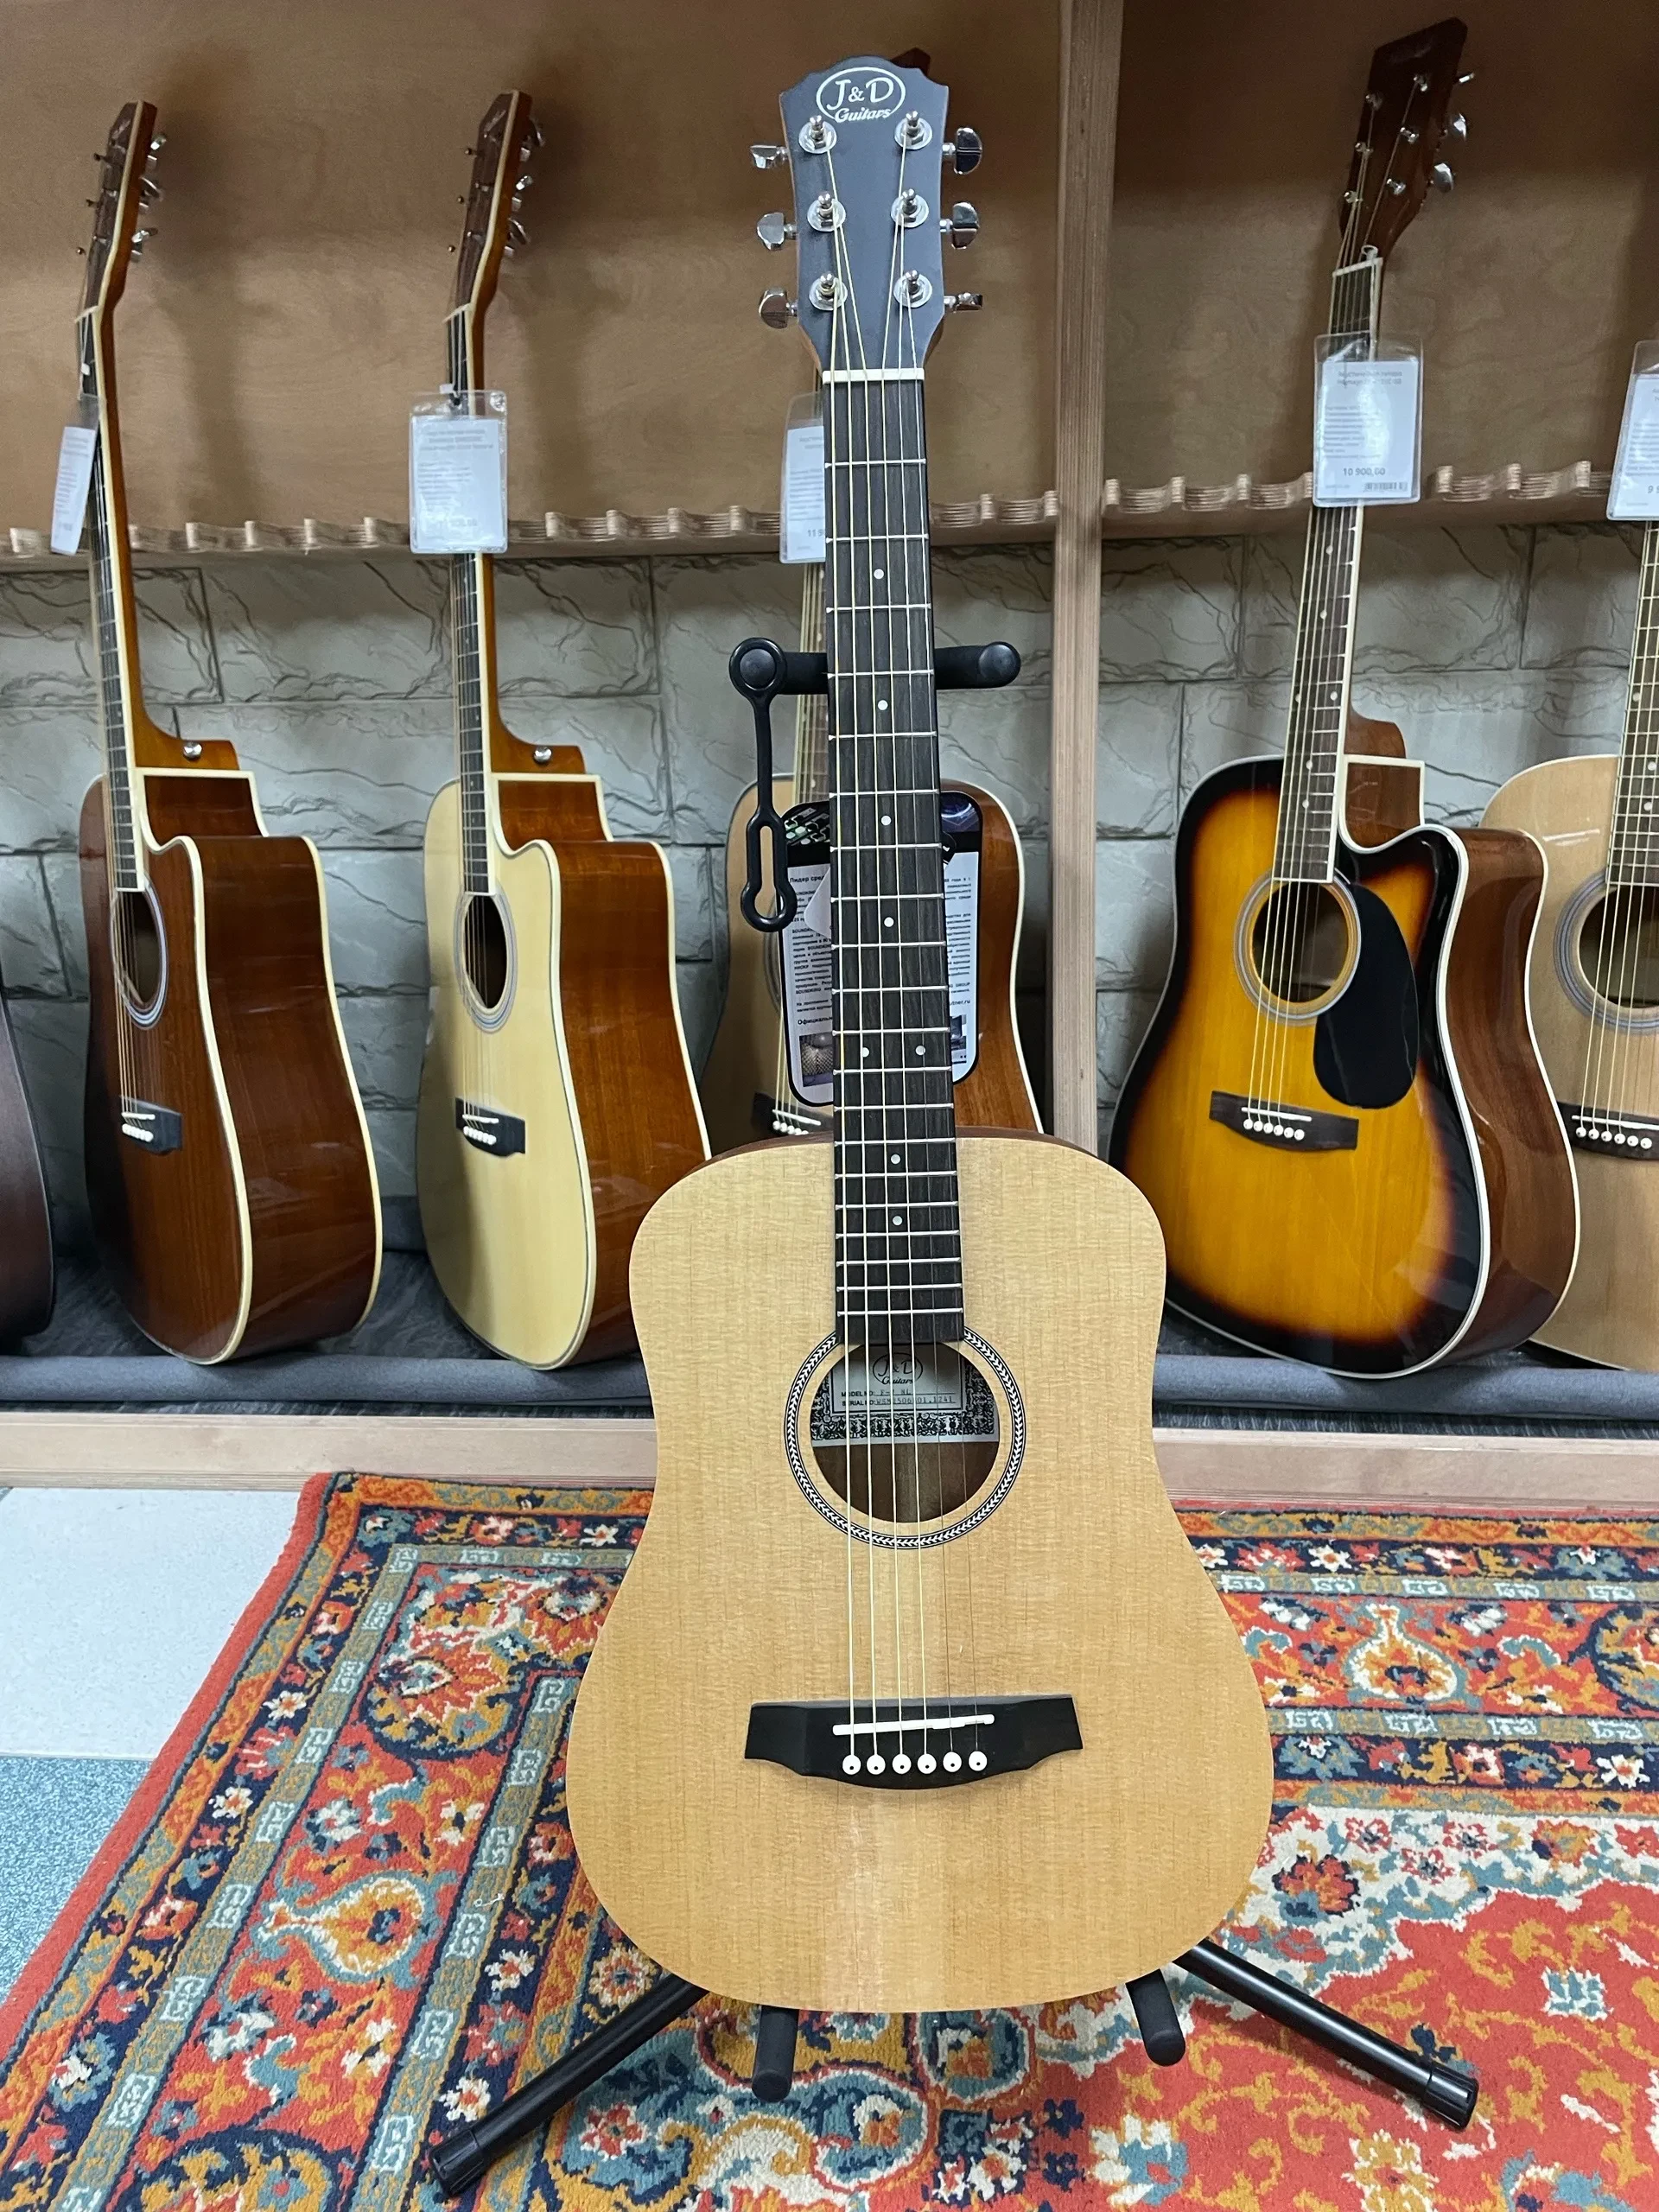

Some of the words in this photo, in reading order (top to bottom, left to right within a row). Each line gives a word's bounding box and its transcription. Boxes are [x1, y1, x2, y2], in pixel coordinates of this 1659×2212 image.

[827, 77, 894, 111] J&D
[835, 107, 892, 123] Guitars
[1343, 467, 1353, 476] 10
[881, 1376, 913, 1385] Guitars
